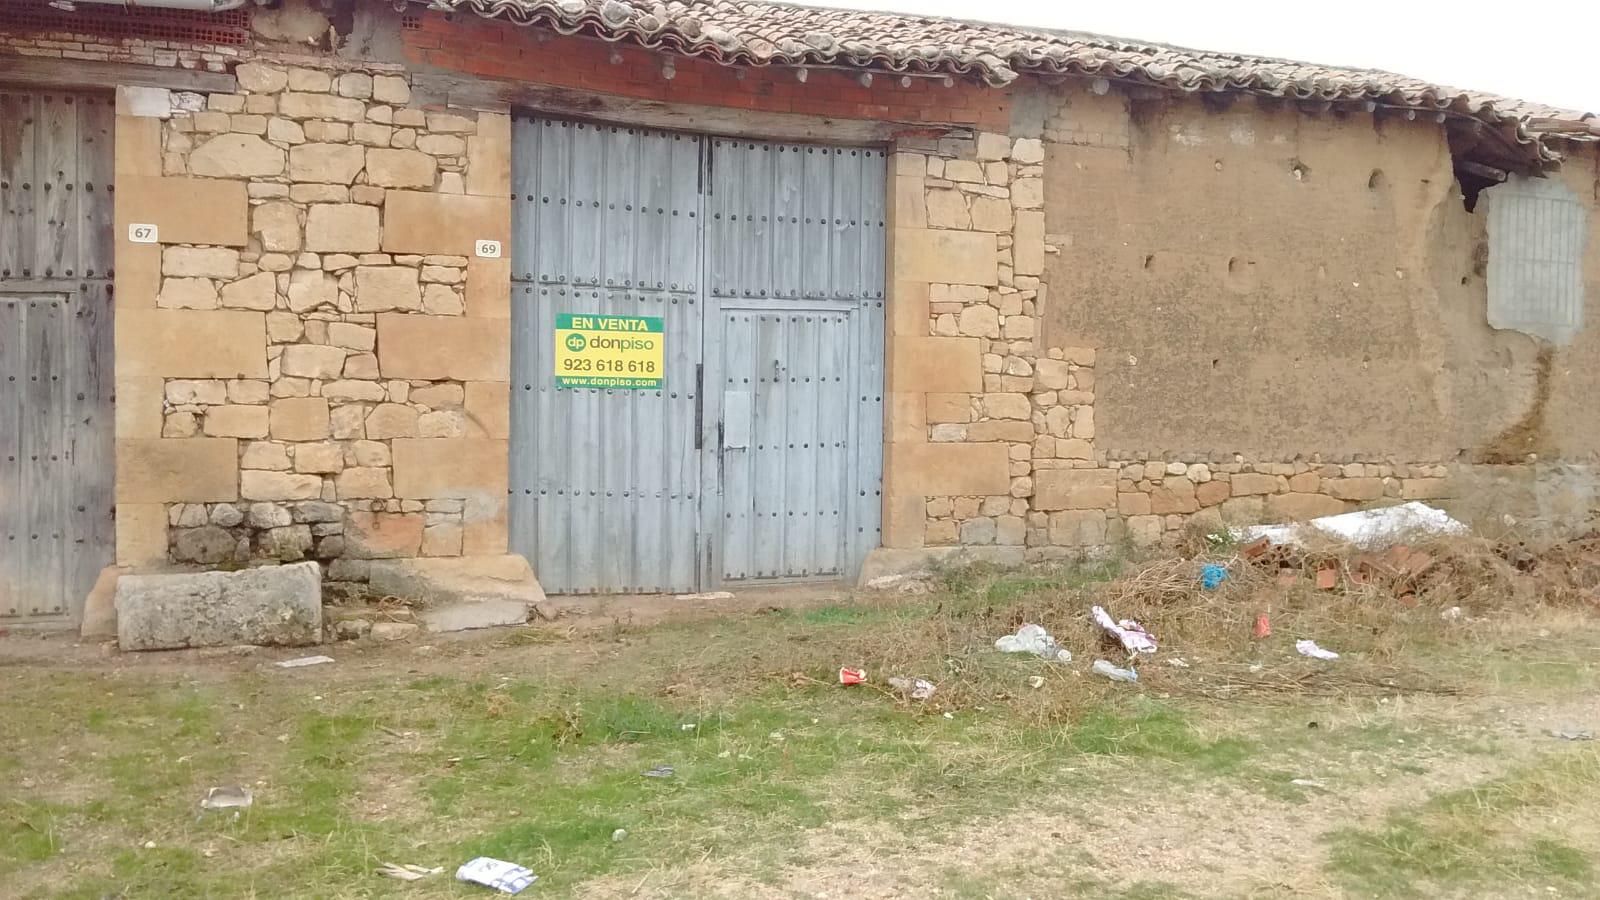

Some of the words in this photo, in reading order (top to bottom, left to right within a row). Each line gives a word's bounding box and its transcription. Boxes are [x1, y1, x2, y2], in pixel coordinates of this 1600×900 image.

[135, 228, 151, 238] 67
[481, 244, 496, 254] 69
[572, 317, 593, 329] EN
[598, 318, 648, 331] VENTA
[567, 336, 584, 349] dp
[590, 336, 654, 352] donpiso
[564, 358, 591, 371] 923
[596, 359, 623, 372] 618
[628, 360, 655, 373] 618
[562, 377, 657, 387] www.donpiso.com
